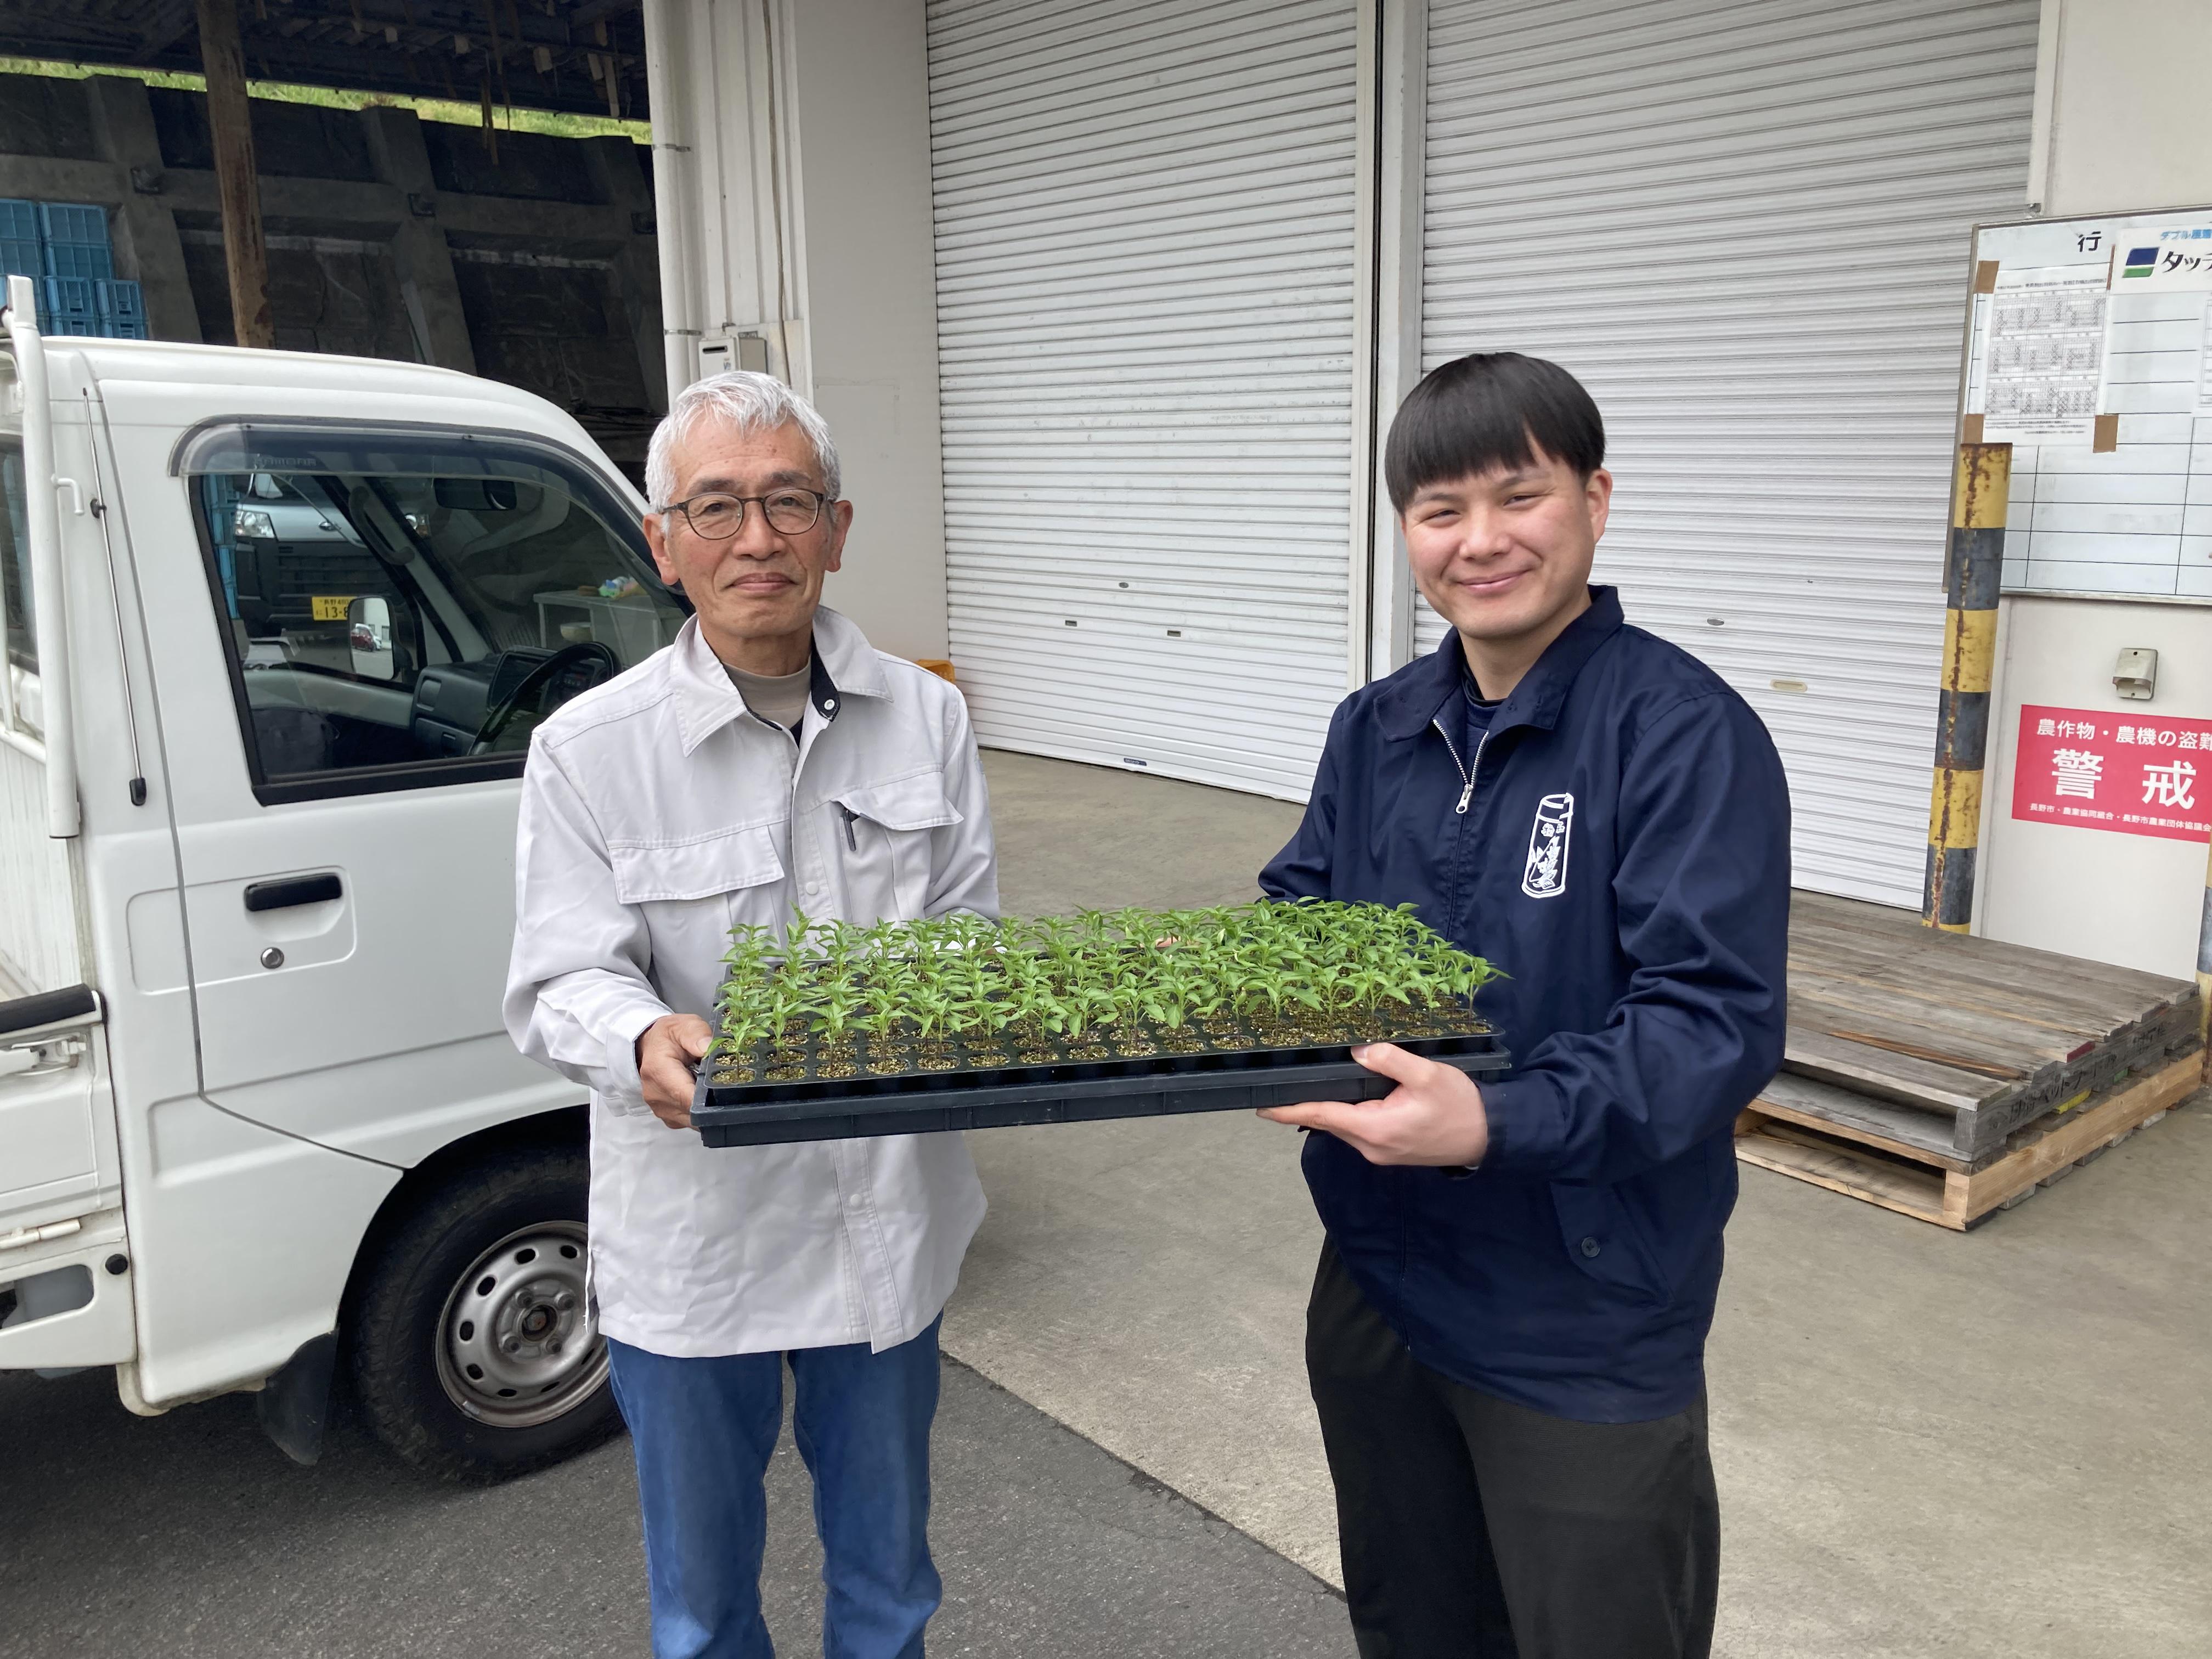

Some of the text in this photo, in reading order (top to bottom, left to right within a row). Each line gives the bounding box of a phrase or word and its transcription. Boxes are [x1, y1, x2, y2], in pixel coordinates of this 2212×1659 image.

[2078, 231, 2102, 252] 行
[2051, 748, 2196, 810] 警 戒
